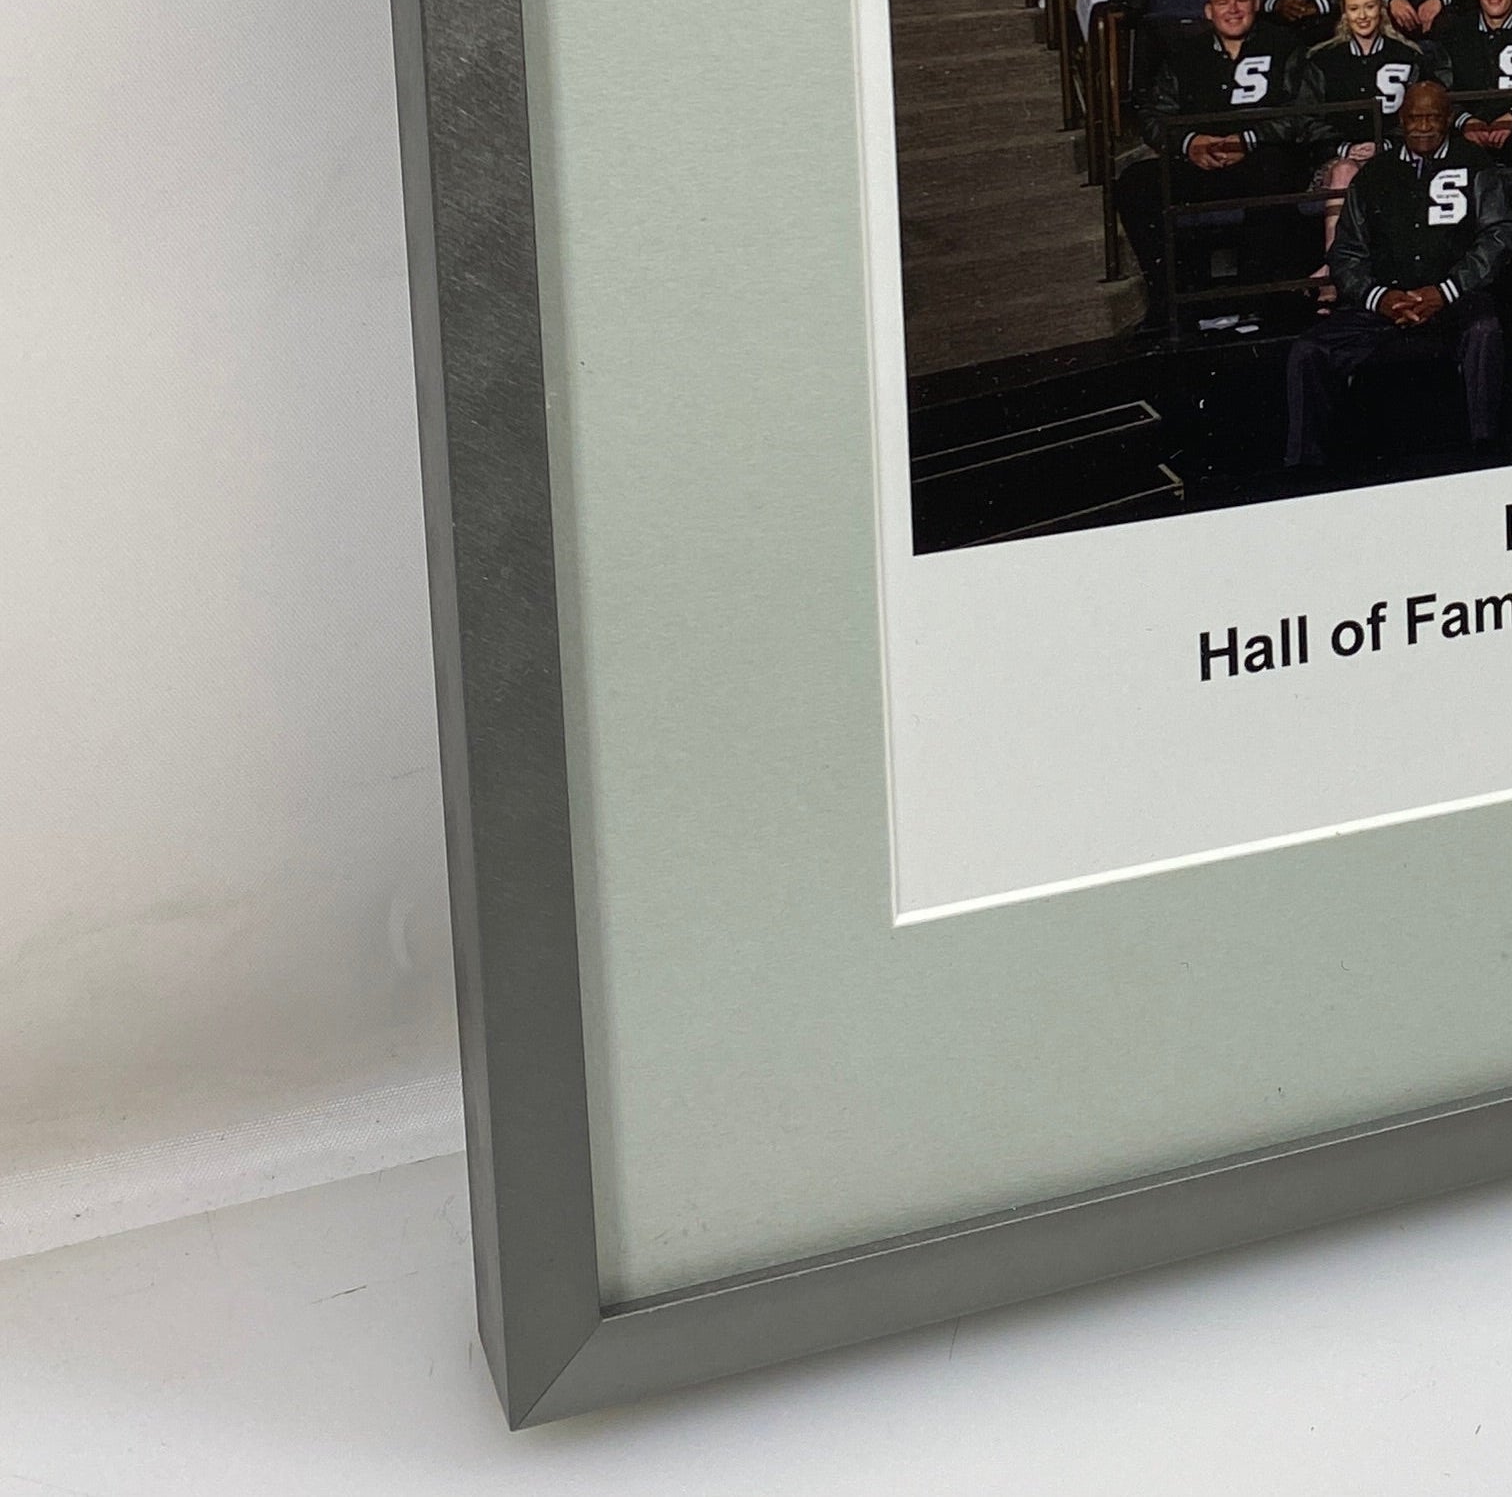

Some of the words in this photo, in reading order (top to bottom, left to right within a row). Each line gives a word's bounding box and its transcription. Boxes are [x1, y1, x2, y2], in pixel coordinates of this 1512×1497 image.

[1231, 56, 1271, 104] S
[1376, 64, 1410, 113] S
[1429, 169, 1467, 225] S
[1199, 614, 1309, 682] Hall
[1331, 601, 1388, 657] of
